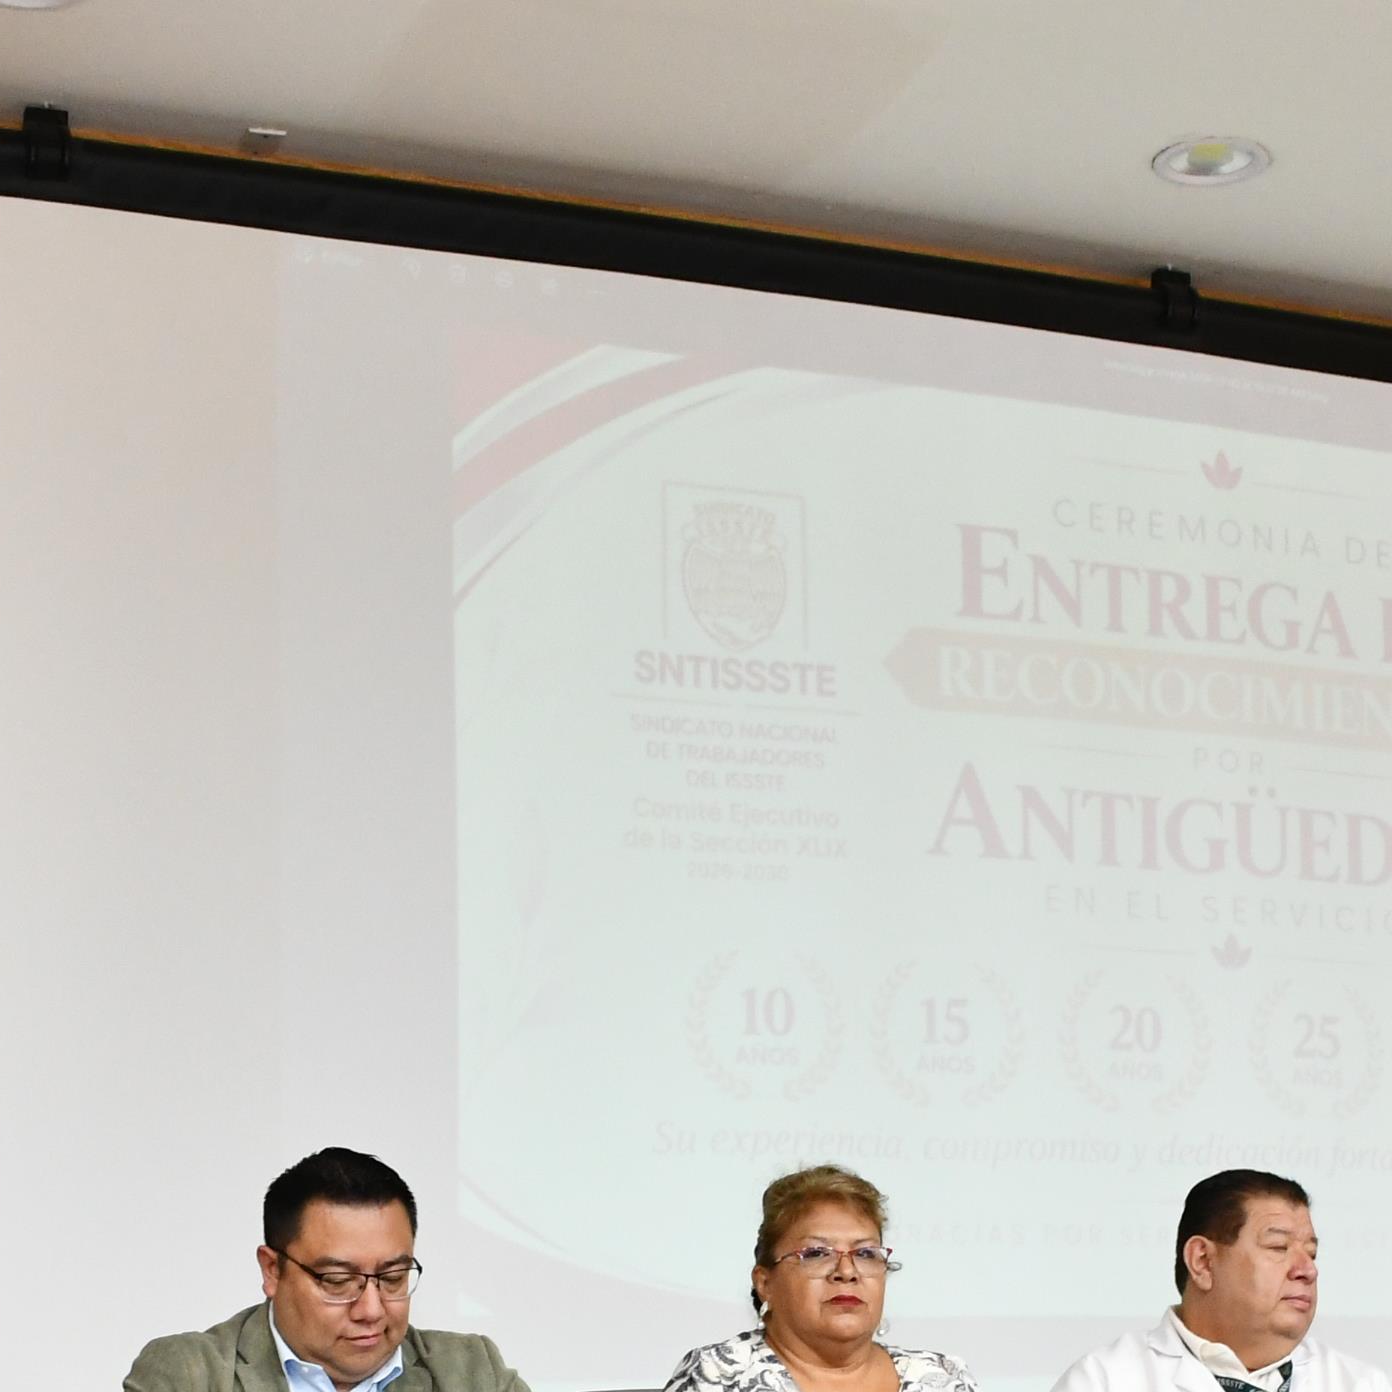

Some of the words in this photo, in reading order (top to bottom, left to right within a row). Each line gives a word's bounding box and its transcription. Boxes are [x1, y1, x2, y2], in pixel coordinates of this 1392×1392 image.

[1051, 497, 1321, 558] CEREMONIA
[1345, 537, 1392, 568] DE
[955, 523, 1358, 660] ENTREGA
[634, 650, 837, 698] SNTISSSTE
[630, 714, 734, 739] SINDICATO
[740, 722, 838, 745] NACIONAL
[646, 741, 670, 760] DE
[678, 743, 825, 769] TRABAJADORES
[686, 770, 717, 788] DEL
[1193, 746, 1265, 775] POR
[633, 795, 722, 822] Comité
[730, 803, 839, 830] Ejecutivo
[623, 828, 654, 849] de
[661, 829, 682, 851] la
[690, 832, 787, 854] Sección
[1045, 885, 1095, 914] EN
[1125, 891, 1169, 921] EL
[739, 987, 796, 1036] 10
[919, 997, 969, 1046] 15
[1108, 1004, 1162, 1053] 20
[1293, 1012, 1341, 1061] 25
[651, 1120, 697, 1157] Su
[923, 1132, 1120, 1171] compromiso
[1127, 1140, 1149, 1173] y
[1158, 1133, 1320, 1170] dedicación
